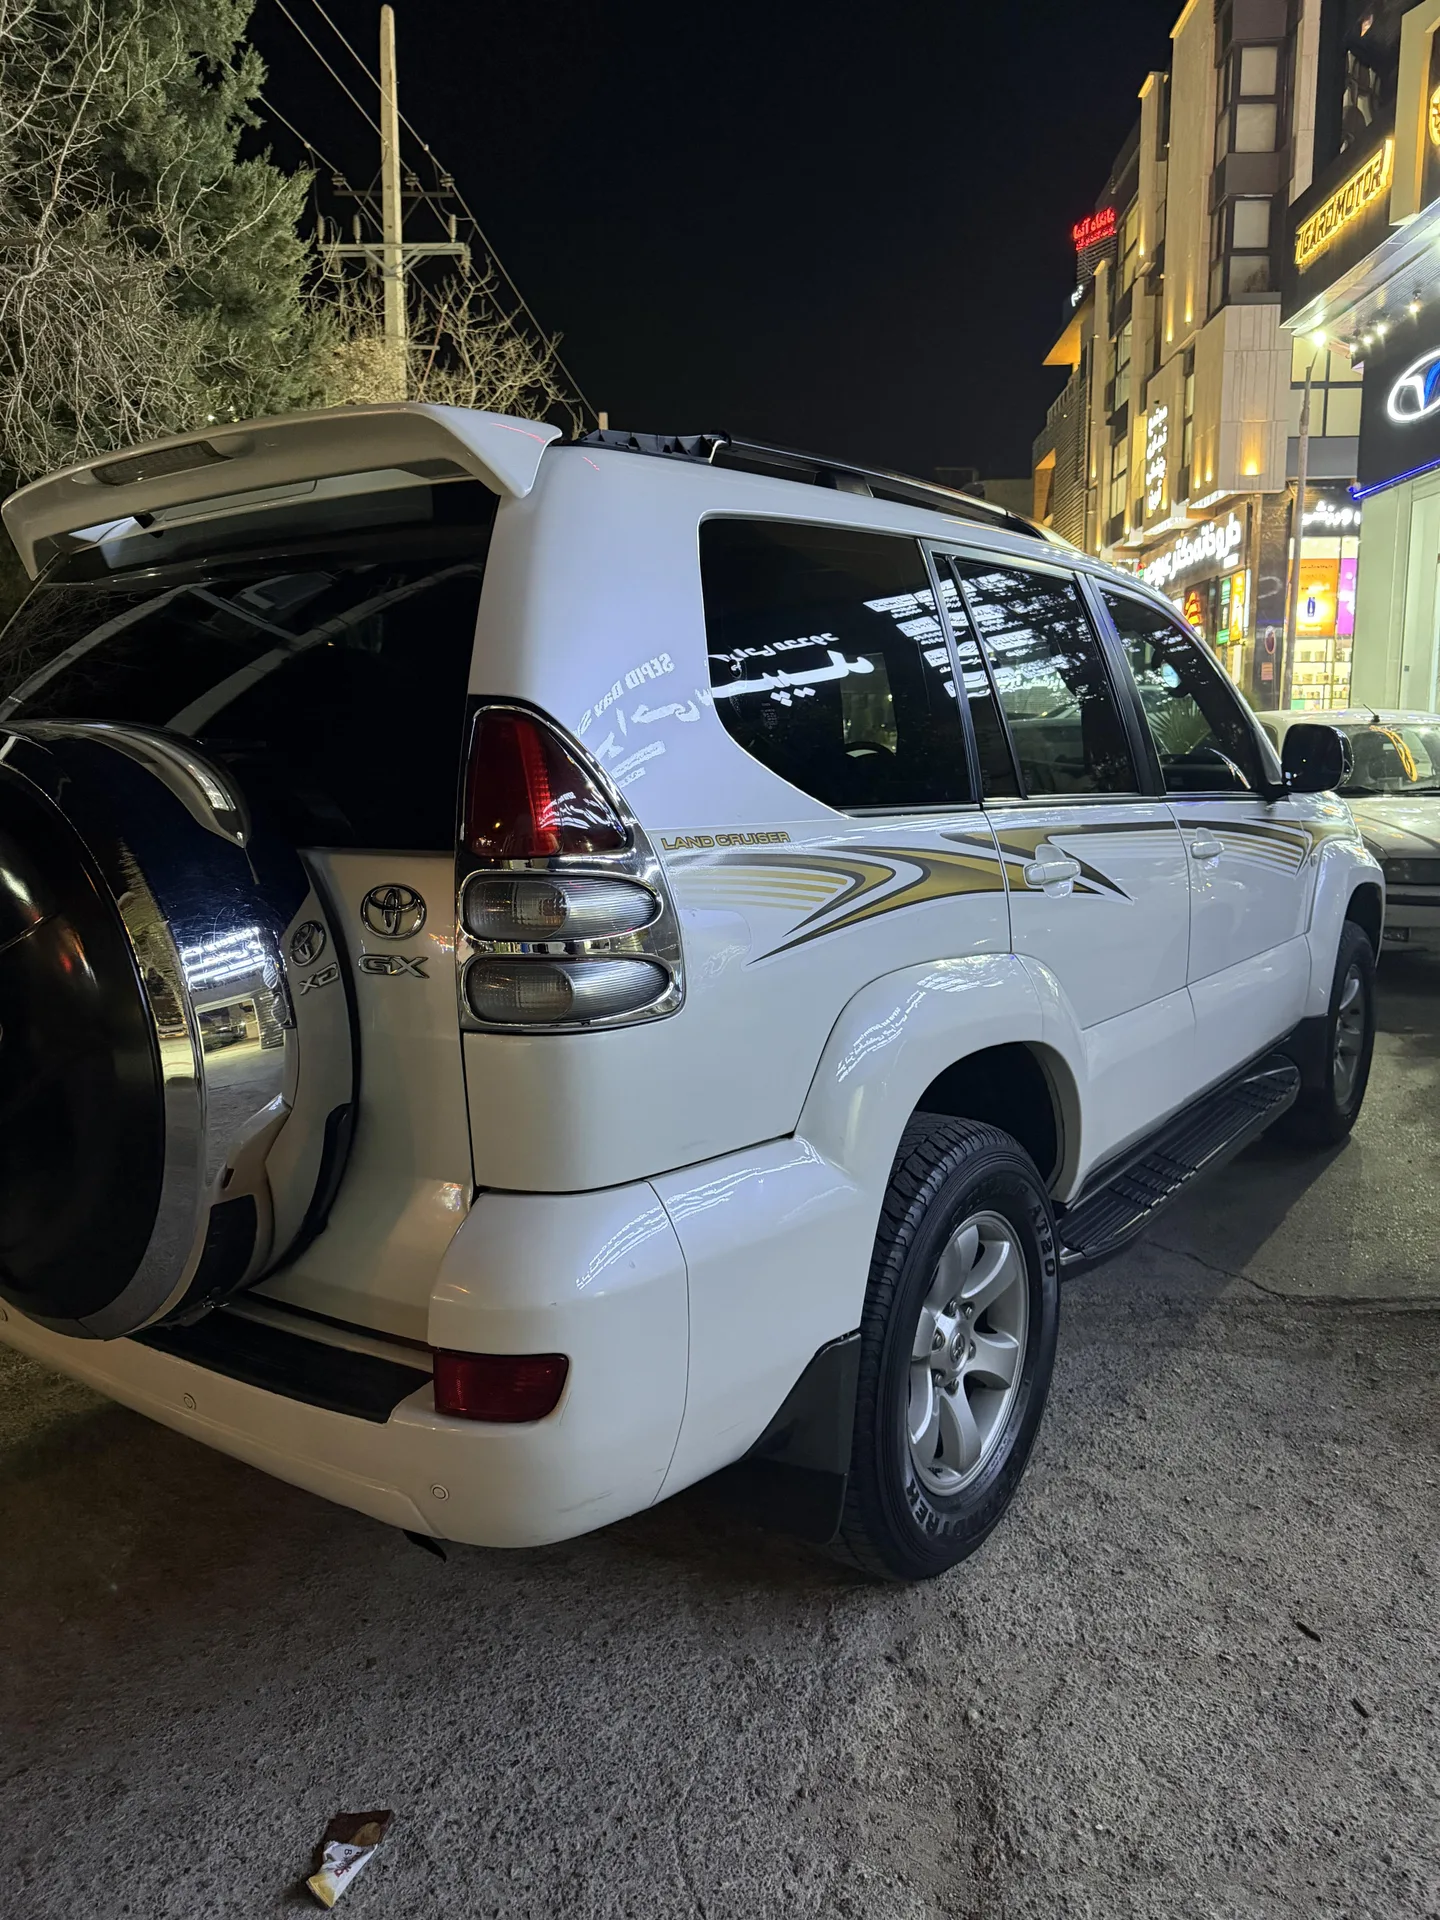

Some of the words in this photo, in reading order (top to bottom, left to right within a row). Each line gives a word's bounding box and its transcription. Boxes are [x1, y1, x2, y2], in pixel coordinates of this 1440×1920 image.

[661, 836, 715, 851] LAND
[715, 831, 791, 848] CRUISER
[358, 953, 430, 979] GX
[1028, 1204, 1056, 1277] AT20
